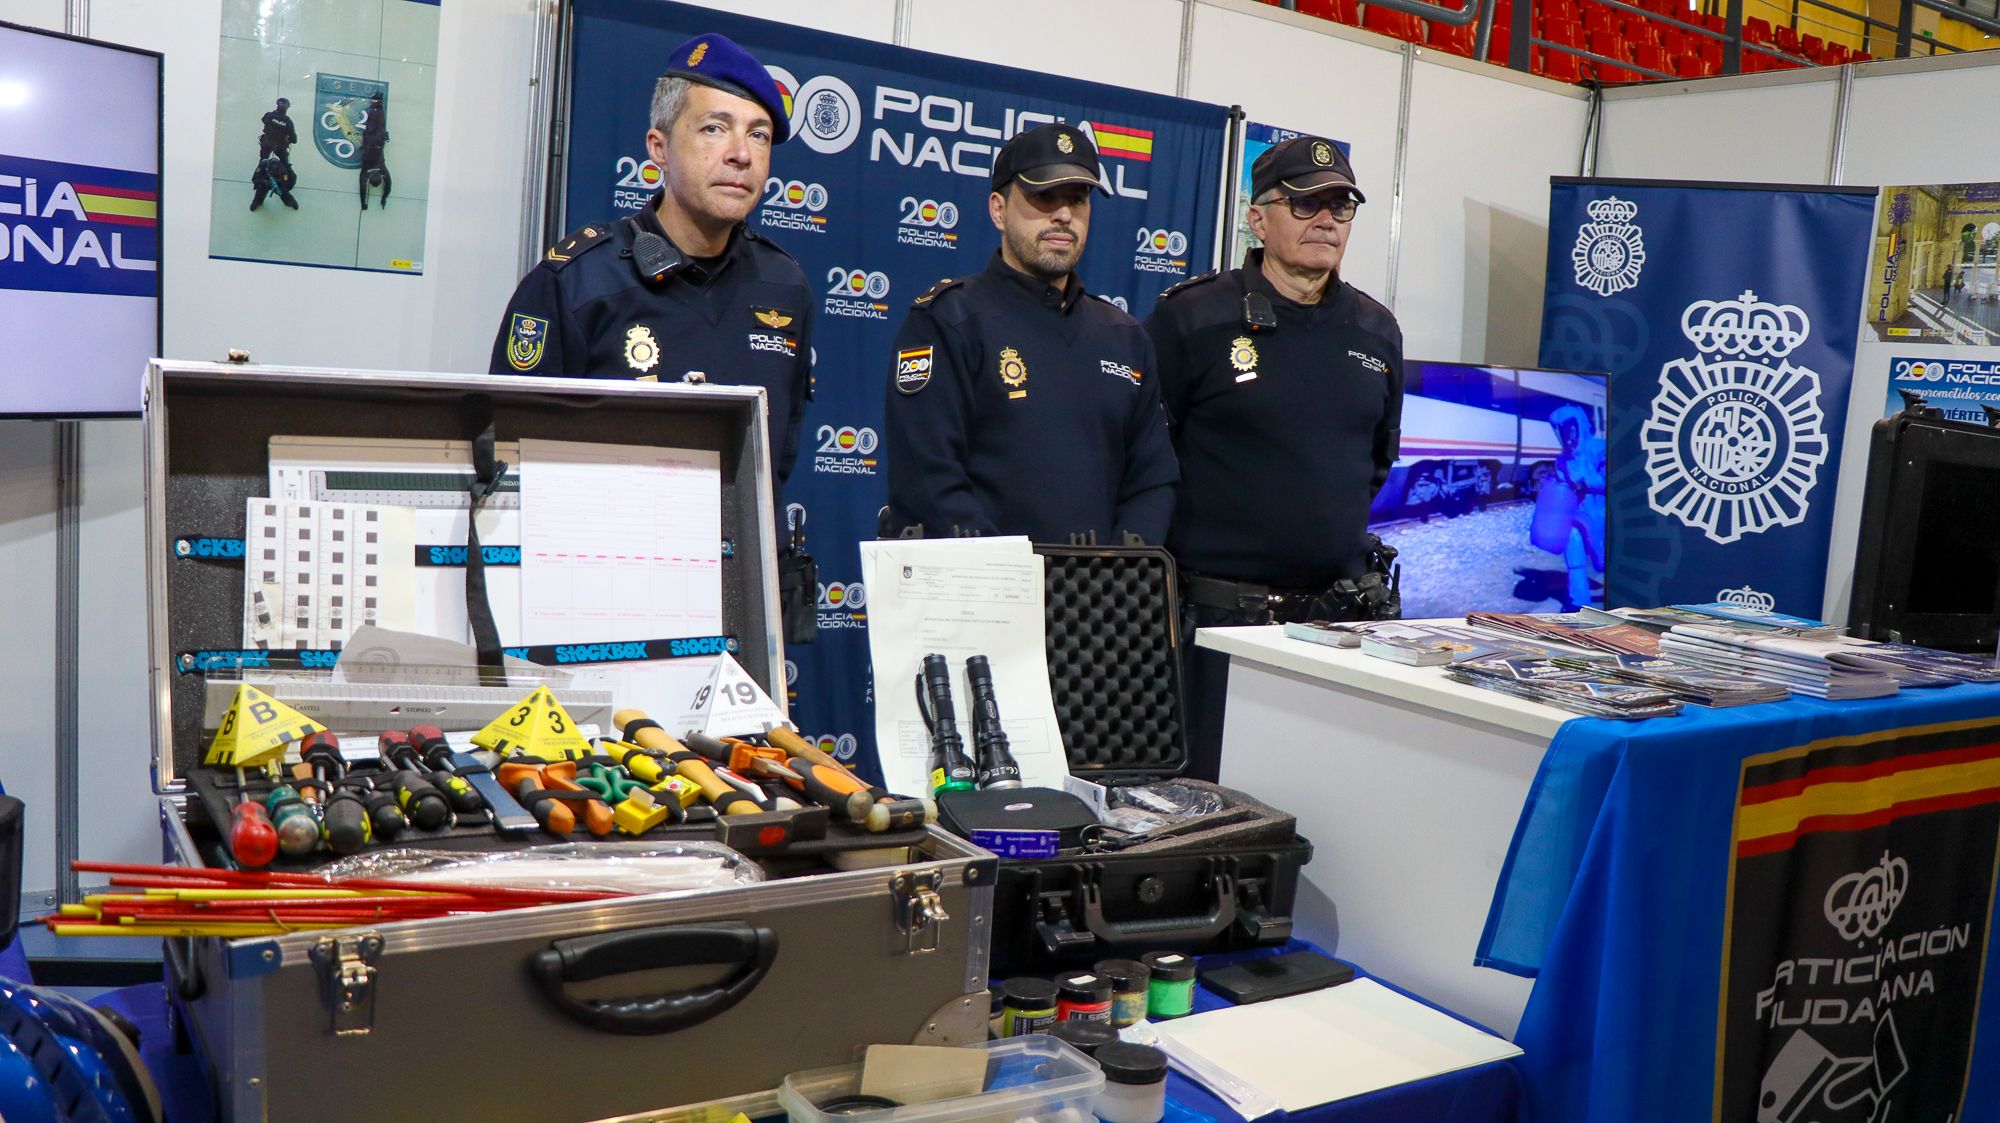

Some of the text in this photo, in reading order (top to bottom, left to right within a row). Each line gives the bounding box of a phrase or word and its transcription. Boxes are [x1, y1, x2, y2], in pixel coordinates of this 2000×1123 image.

[764, 176, 828, 212] 200
[900, 196, 959, 229] 200
[761, 217, 826, 233] NACIONAL
[897, 235, 957, 250] NACIONAL
[1136, 226, 1187, 257] 200
[1134, 263, 1186, 275] NACIONAL
[827, 266, 890, 299] 200
[825, 306, 888, 320] NACIONAL
[1895, 361, 1945, 382] 200
[817, 424, 879, 455] 200
[814, 464, 877, 475] NACIONAL
[1690, 465, 1771, 494] NACIONAL
[690, 684, 712, 710] 19
[720, 681, 758, 706] 19
[223, 710, 237, 735] B
[249, 701, 278, 724] B
[510, 706, 531, 726] 3
[548, 711, 565, 734] 3
